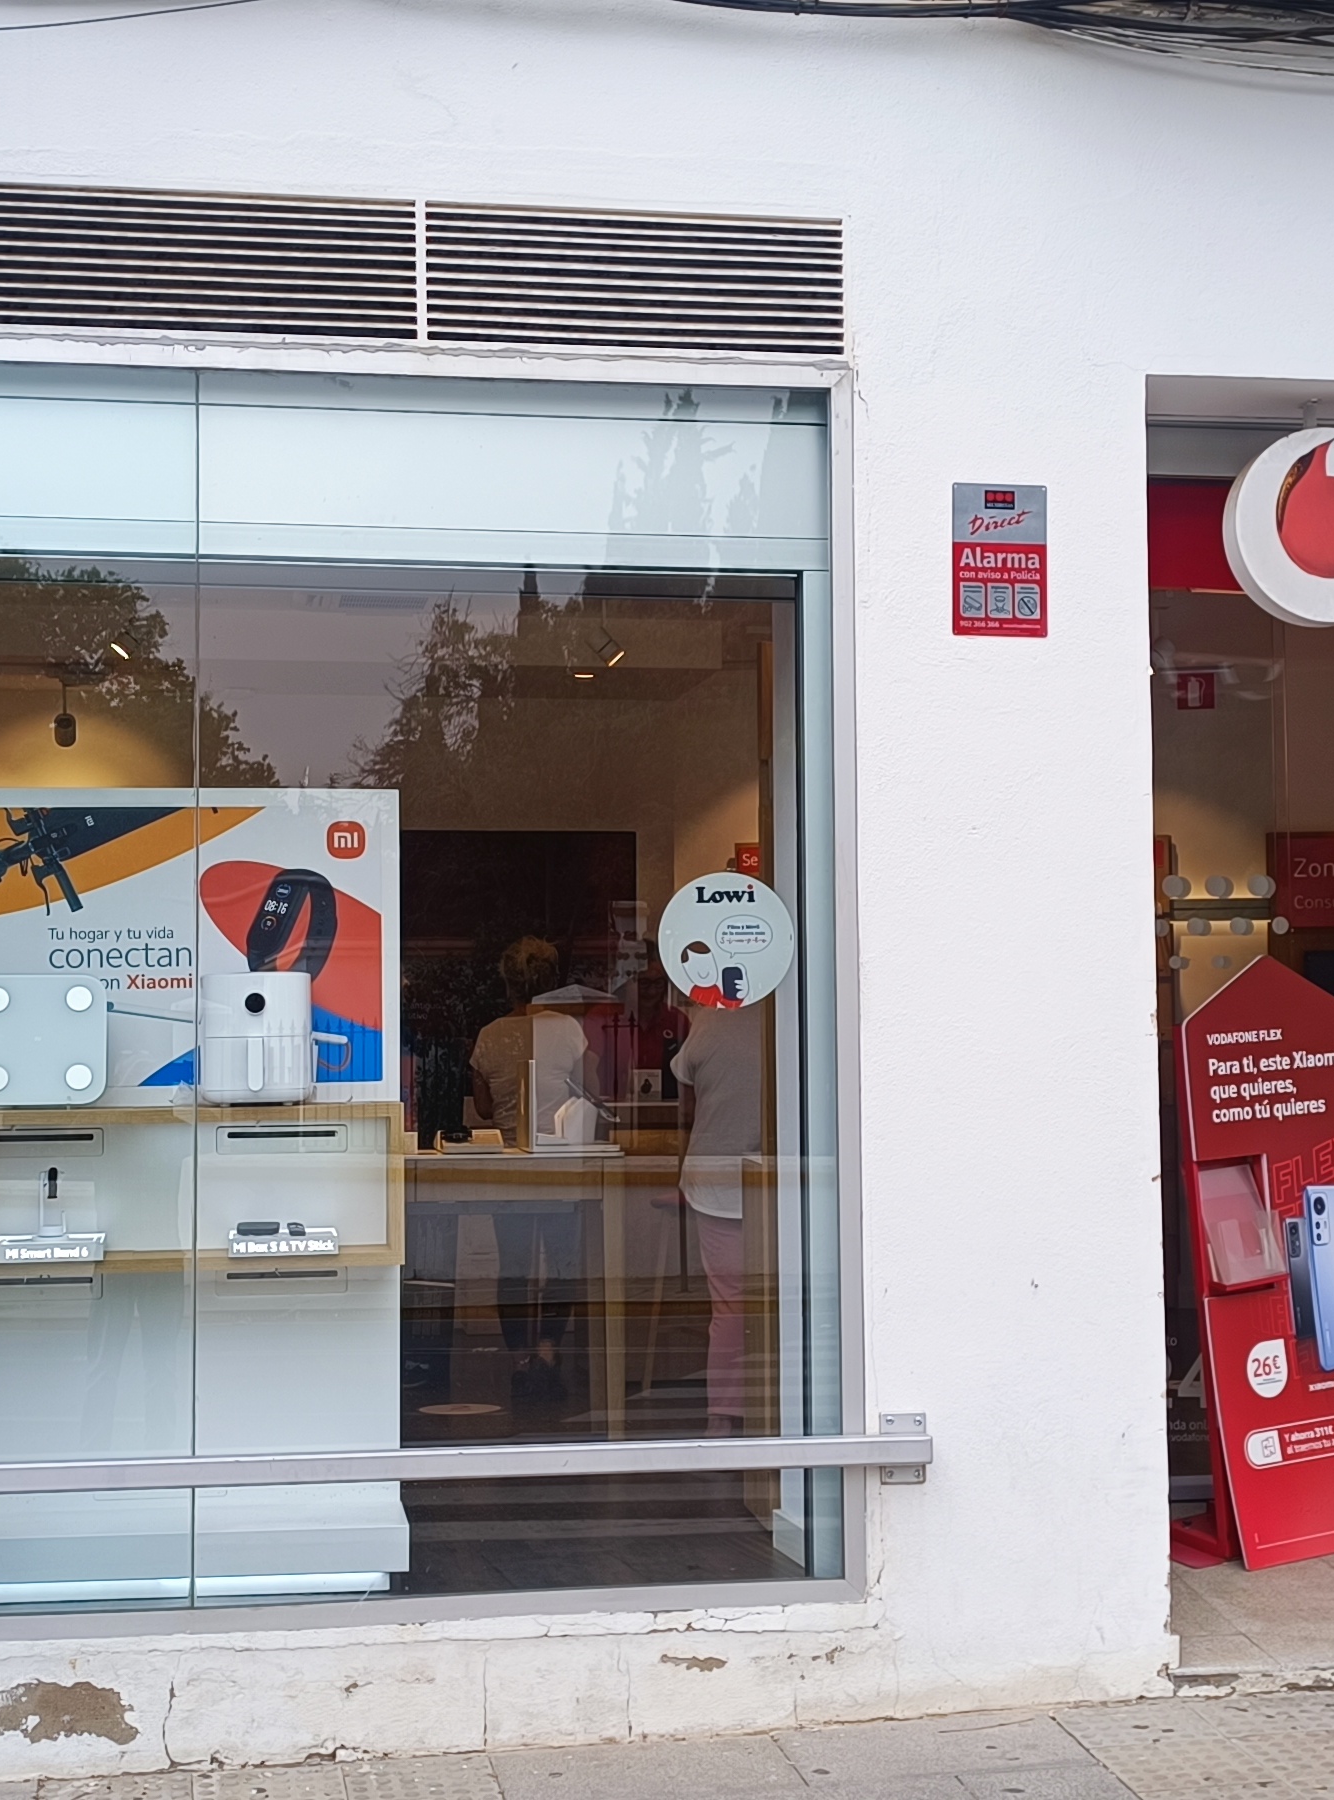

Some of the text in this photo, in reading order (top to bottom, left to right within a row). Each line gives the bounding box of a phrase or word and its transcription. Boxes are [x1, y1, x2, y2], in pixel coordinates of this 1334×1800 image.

[968, 509, 1033, 535] Direct
[960, 547, 1040, 568] Alarma
[978, 570, 1001, 579] aviso
[1010, 570, 1040, 580] Policía
[695, 884, 756, 904] Lowi
[47, 925, 174, 943] Tu hogar y tu vida
[48, 943, 192, 969] conectan
[99, 973, 193, 990] on Xiaomi
[1207, 1029, 1283, 1045] VODAFONE FLEX
[1208, 1057, 1240, 1076] Para
[1242, 1055, 1257, 1075] ti,
[1260, 1055, 1290, 1072] este
[1210, 1078, 1297, 1103] que quieres,
[1212, 1098, 1326, 1123] como tú quieres
[269, 1241, 278, 1253] S
[279, 1240, 289, 1252] &
[289, 1240, 307, 1252] TV
